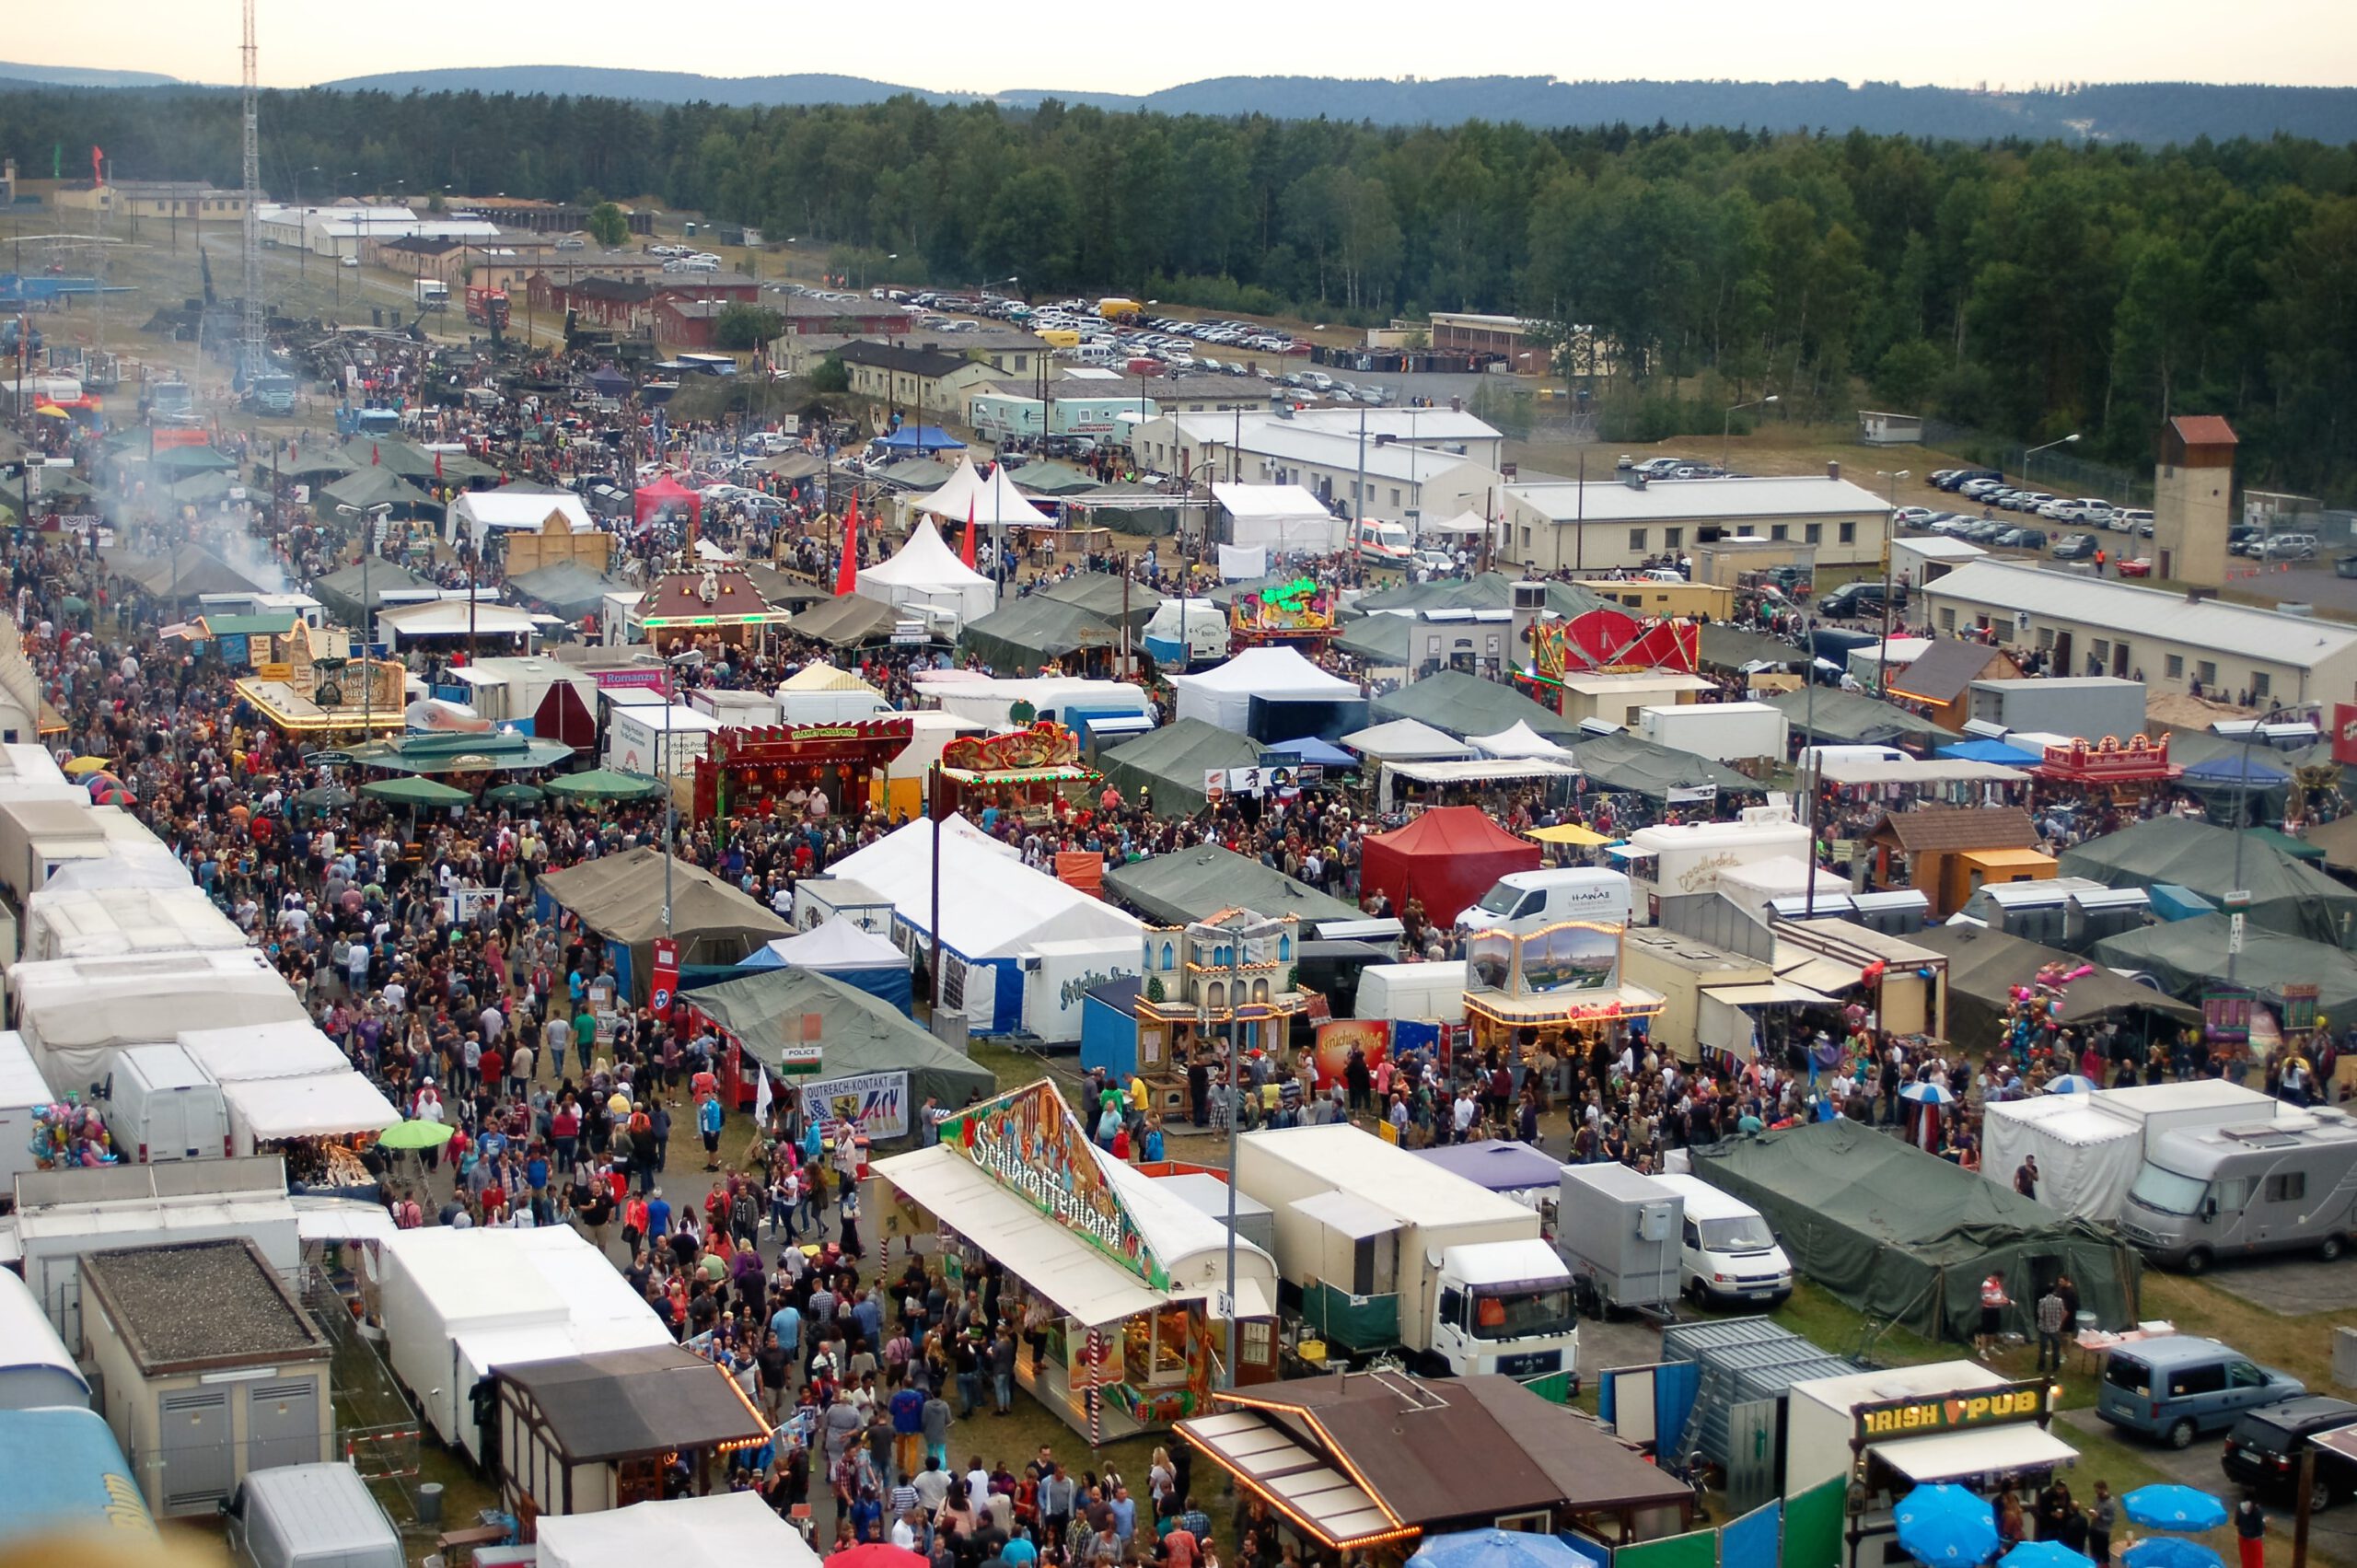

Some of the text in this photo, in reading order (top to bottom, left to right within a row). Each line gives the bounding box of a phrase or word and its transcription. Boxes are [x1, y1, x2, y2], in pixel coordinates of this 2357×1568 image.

[607, 673, 656, 683] Romanze
[1572, 891, 1609, 901] HAWAII
[807, 1076, 888, 1098] OUTREACH-KONTAKT
[969, 1121, 1120, 1250] Schlaraffenland
[1225, 1300, 1232, 1316] A
[1514, 1357, 1544, 1367] MAN
[1864, 1390, 2037, 1434] IRISH PUB
